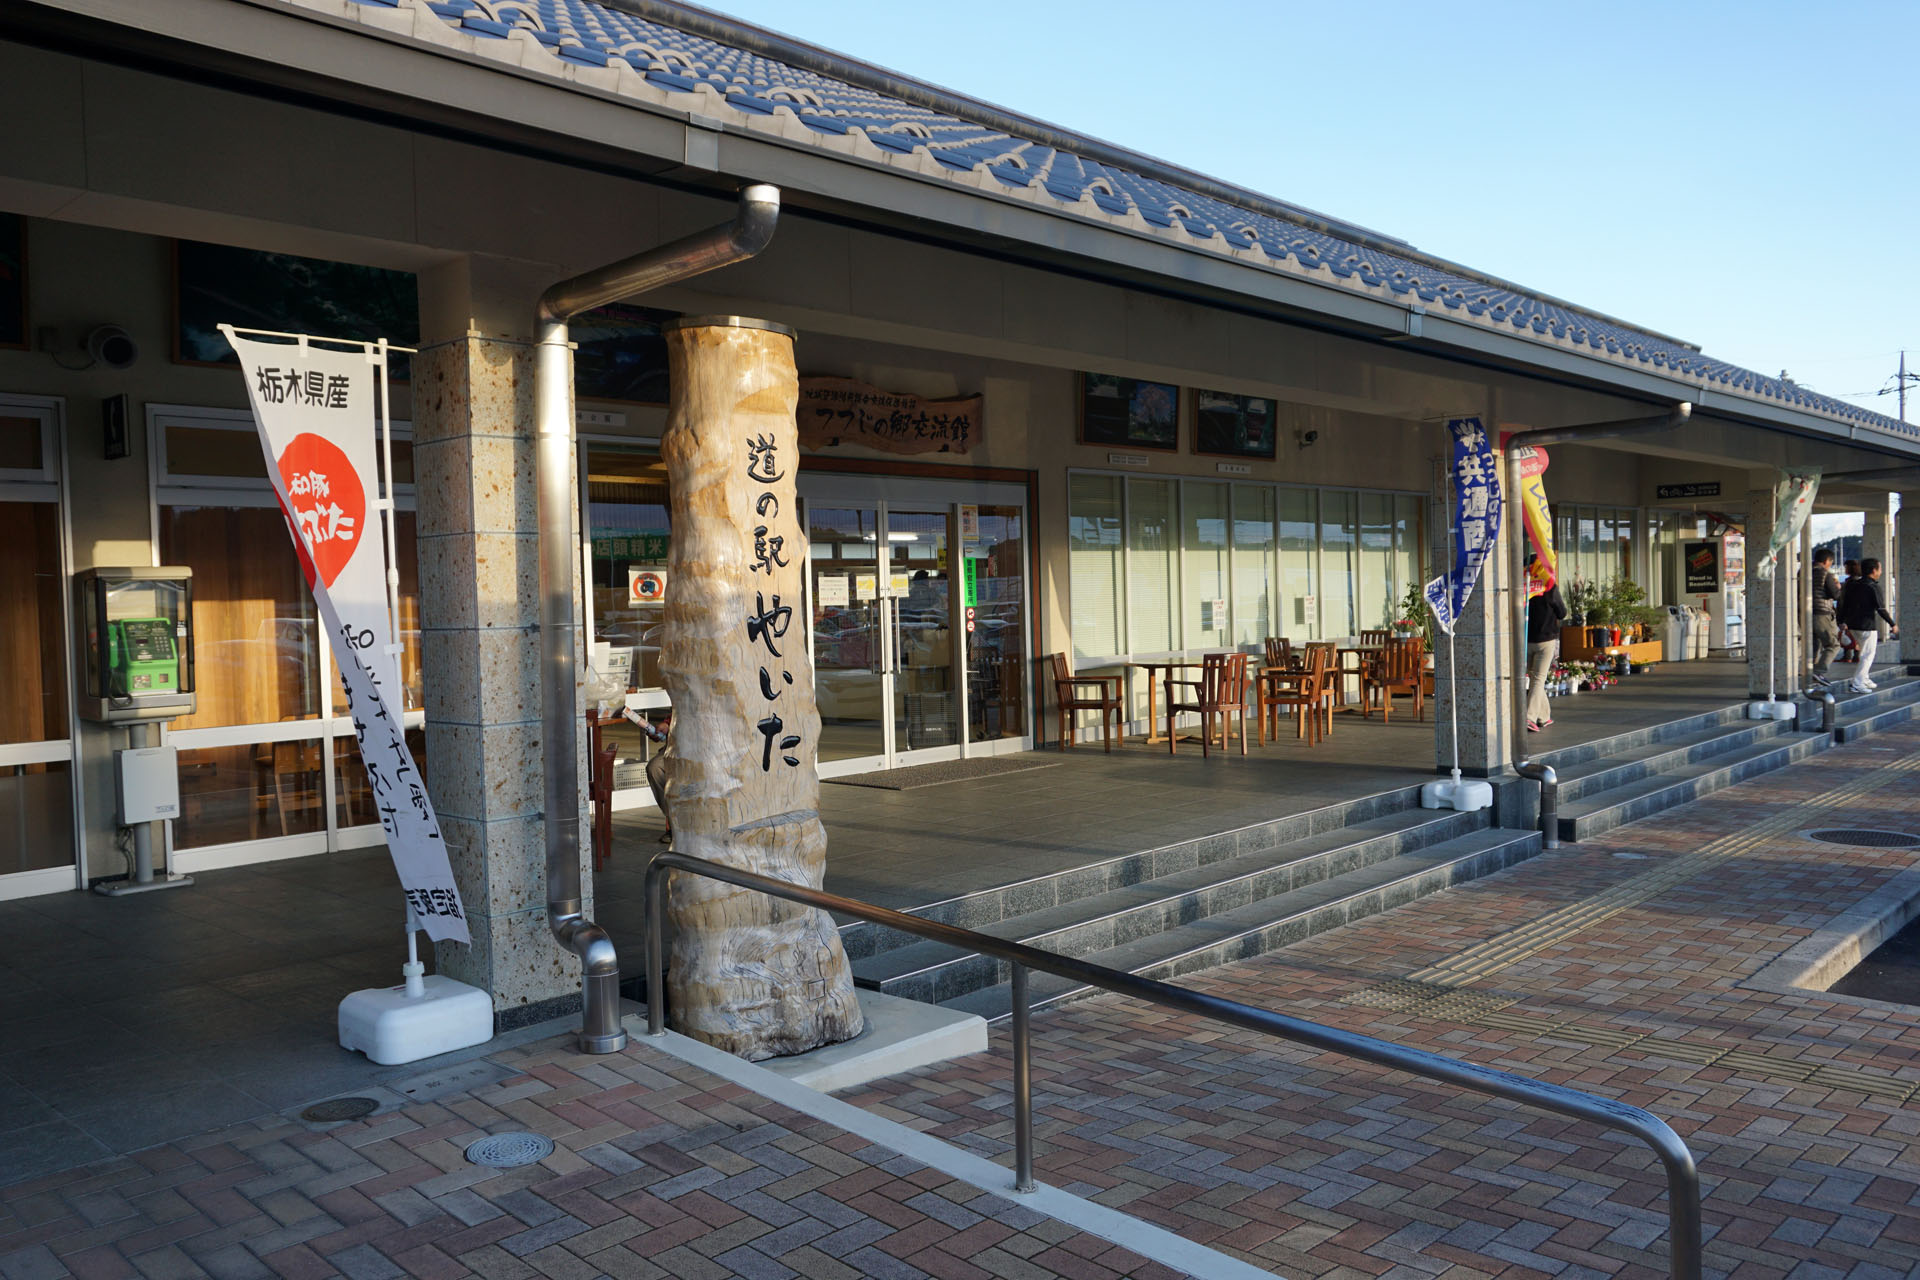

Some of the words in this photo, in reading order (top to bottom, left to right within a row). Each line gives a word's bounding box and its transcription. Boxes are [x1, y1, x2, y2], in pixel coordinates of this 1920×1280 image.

[256, 366, 350, 409] 栃木県産
[815, 407, 971, 441] つつじの郷交流館
[288, 469, 330, 499] 和豚
[746, 432, 802, 773] 道の駅やいた
